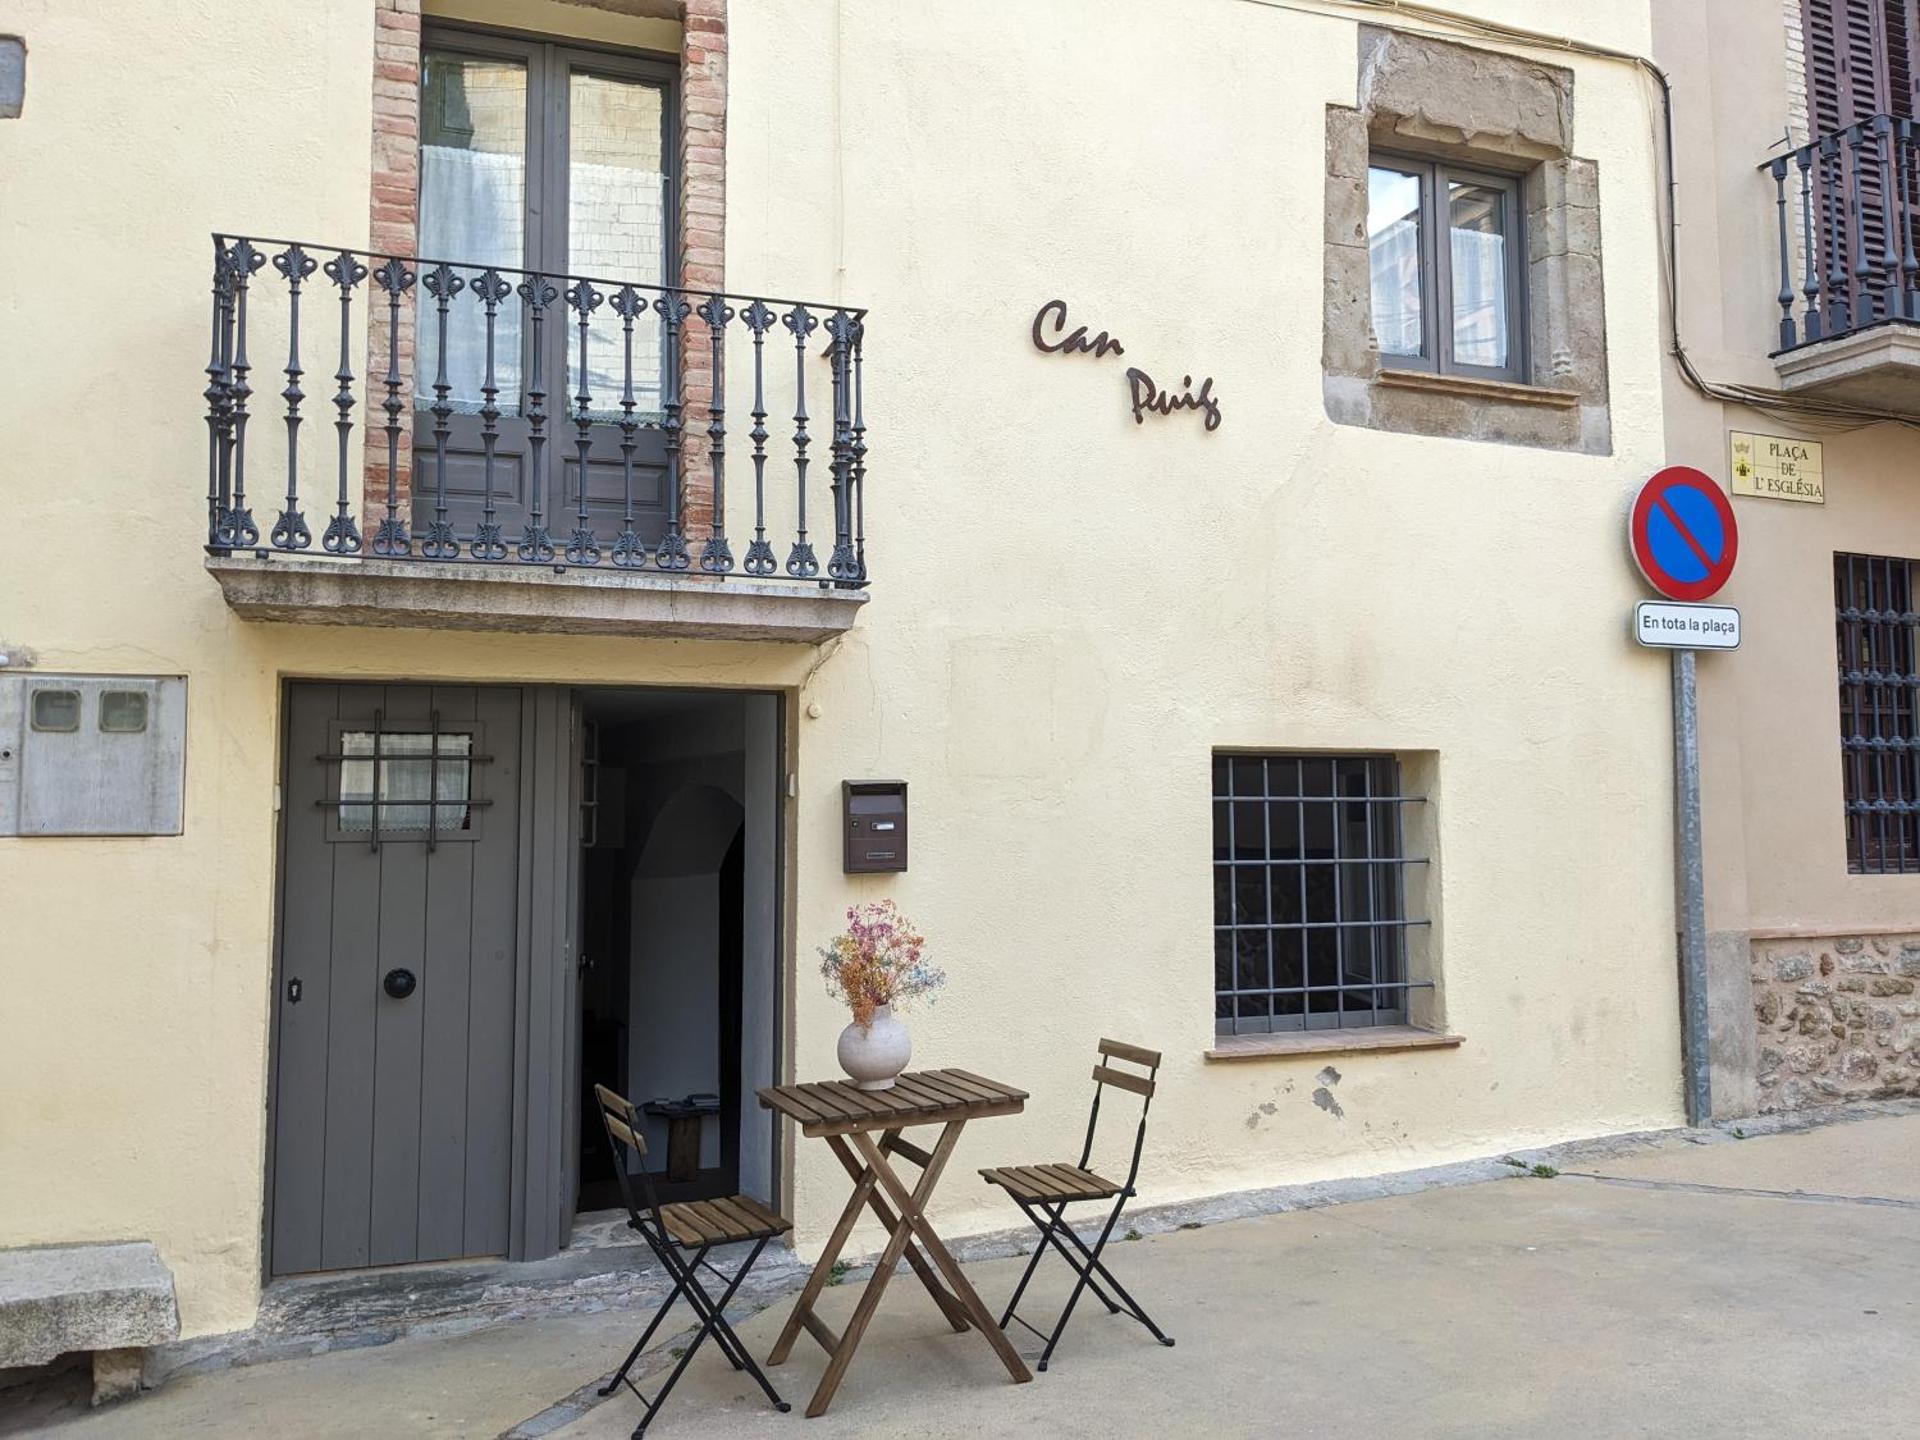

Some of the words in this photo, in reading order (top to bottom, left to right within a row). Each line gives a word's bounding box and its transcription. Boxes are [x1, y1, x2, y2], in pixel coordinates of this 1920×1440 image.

[1032, 299, 1125, 358] Can
[1126, 367, 1222, 431] Puig
[1769, 443, 1808, 461] PLAÇA
[1781, 462, 1796, 476] DE
[1643, 615, 1659, 629] En
[1662, 617, 1686, 631] tota
[1689, 618, 1700, 631] la
[1702, 619, 1735, 635] plaça
